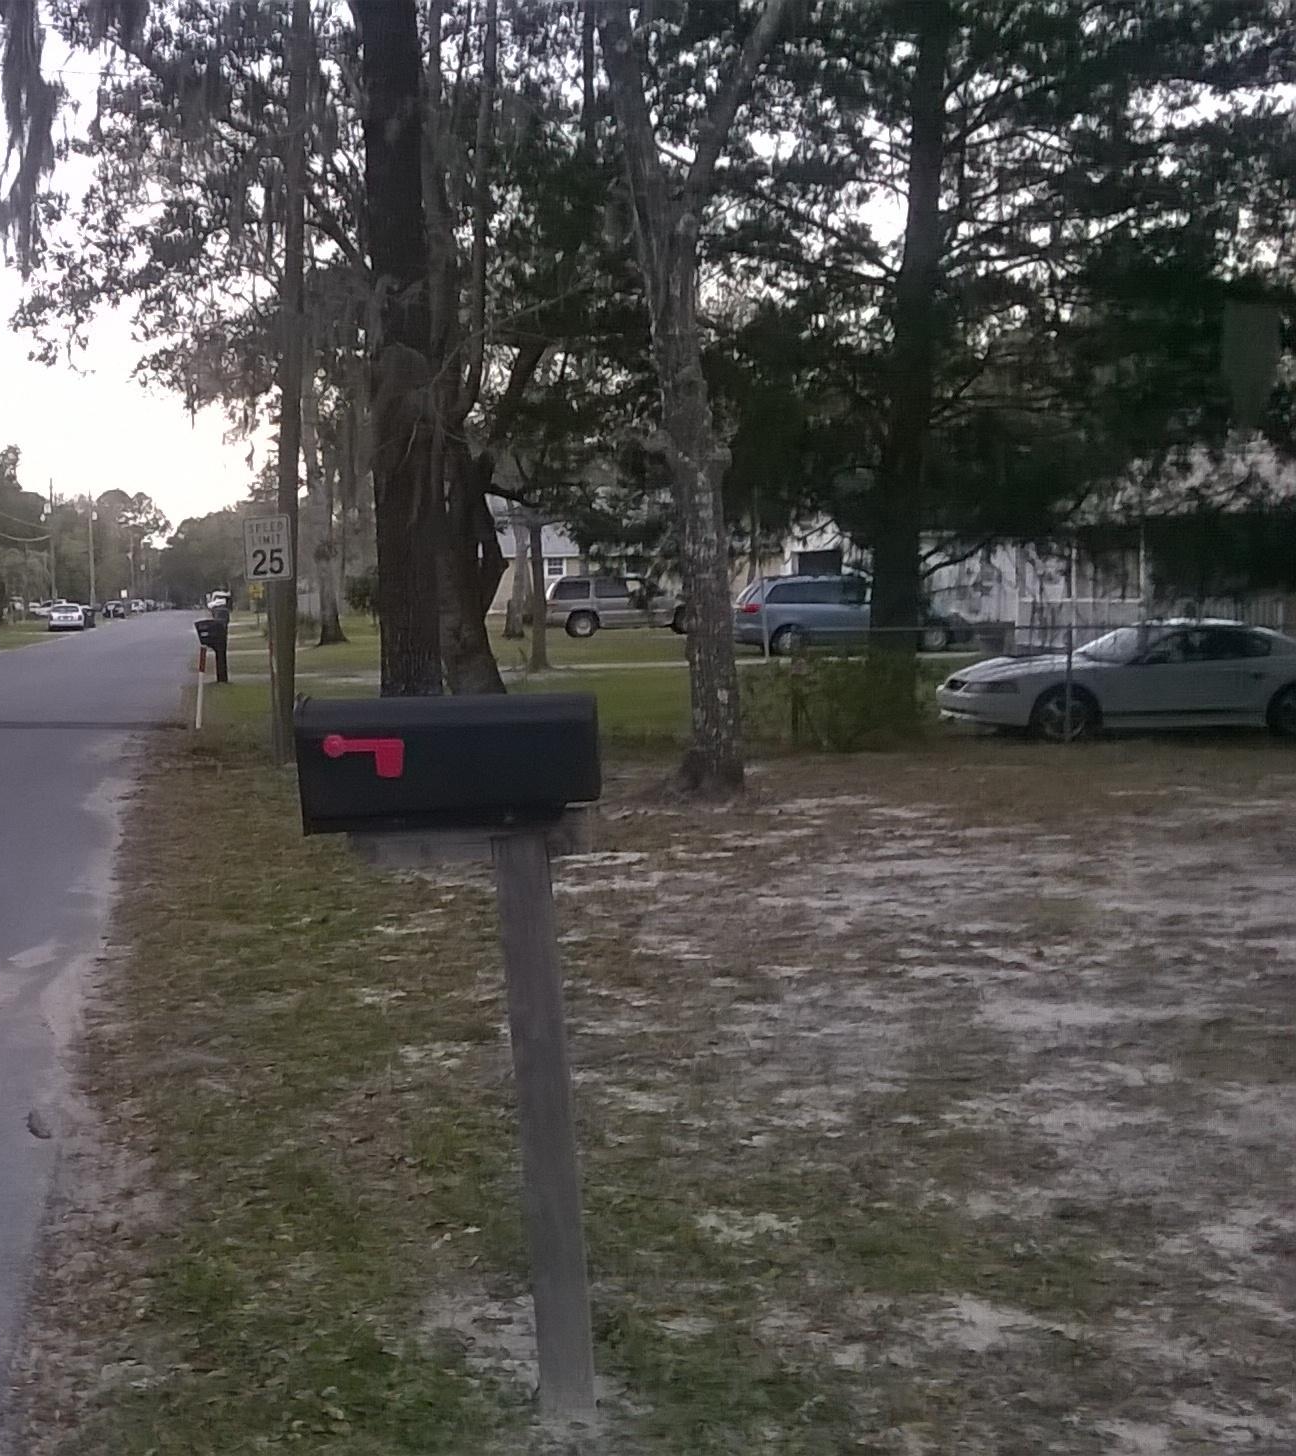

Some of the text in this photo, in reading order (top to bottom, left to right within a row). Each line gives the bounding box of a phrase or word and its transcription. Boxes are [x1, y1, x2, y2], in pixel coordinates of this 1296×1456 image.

[248, 521, 283, 534] SPEED
[251, 534, 280, 545] LIMIT
[252, 549, 284, 576] 25
